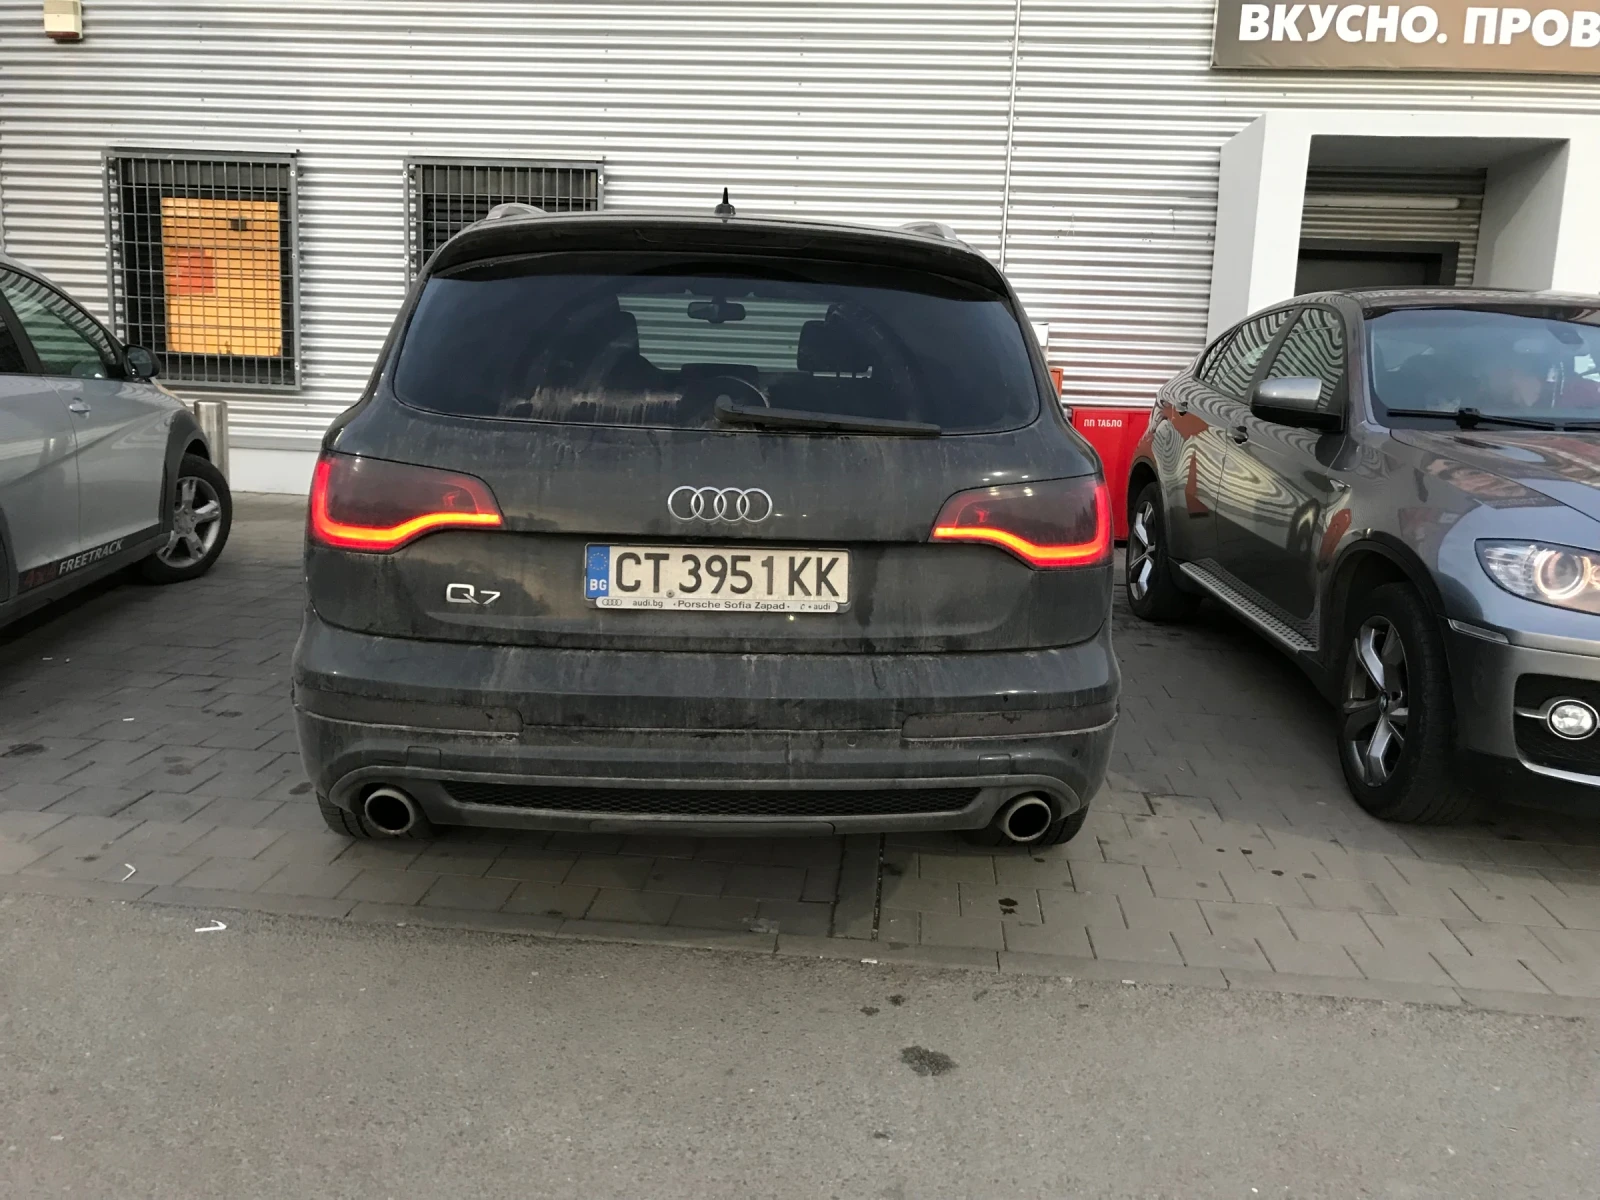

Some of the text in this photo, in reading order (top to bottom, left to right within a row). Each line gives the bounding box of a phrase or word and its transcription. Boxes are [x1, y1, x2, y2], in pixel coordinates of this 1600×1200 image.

[1238, 3, 1600, 47] ВКУСНО. ПРОВ
[1083, 419, 1123, 428] ПП ТАБЛО
[58, 539, 125, 576] FREETRACK
[589, 579, 607, 590] BG
[615, 552, 840, 597] CT 3951 KK
[446, 583, 501, 605] Q7
[632, 599, 664, 609] audi.bg
[677, 600, 721, 610] Porsche
[724, 601, 752, 610] Sofia
[754, 601, 786, 611] Zapad
